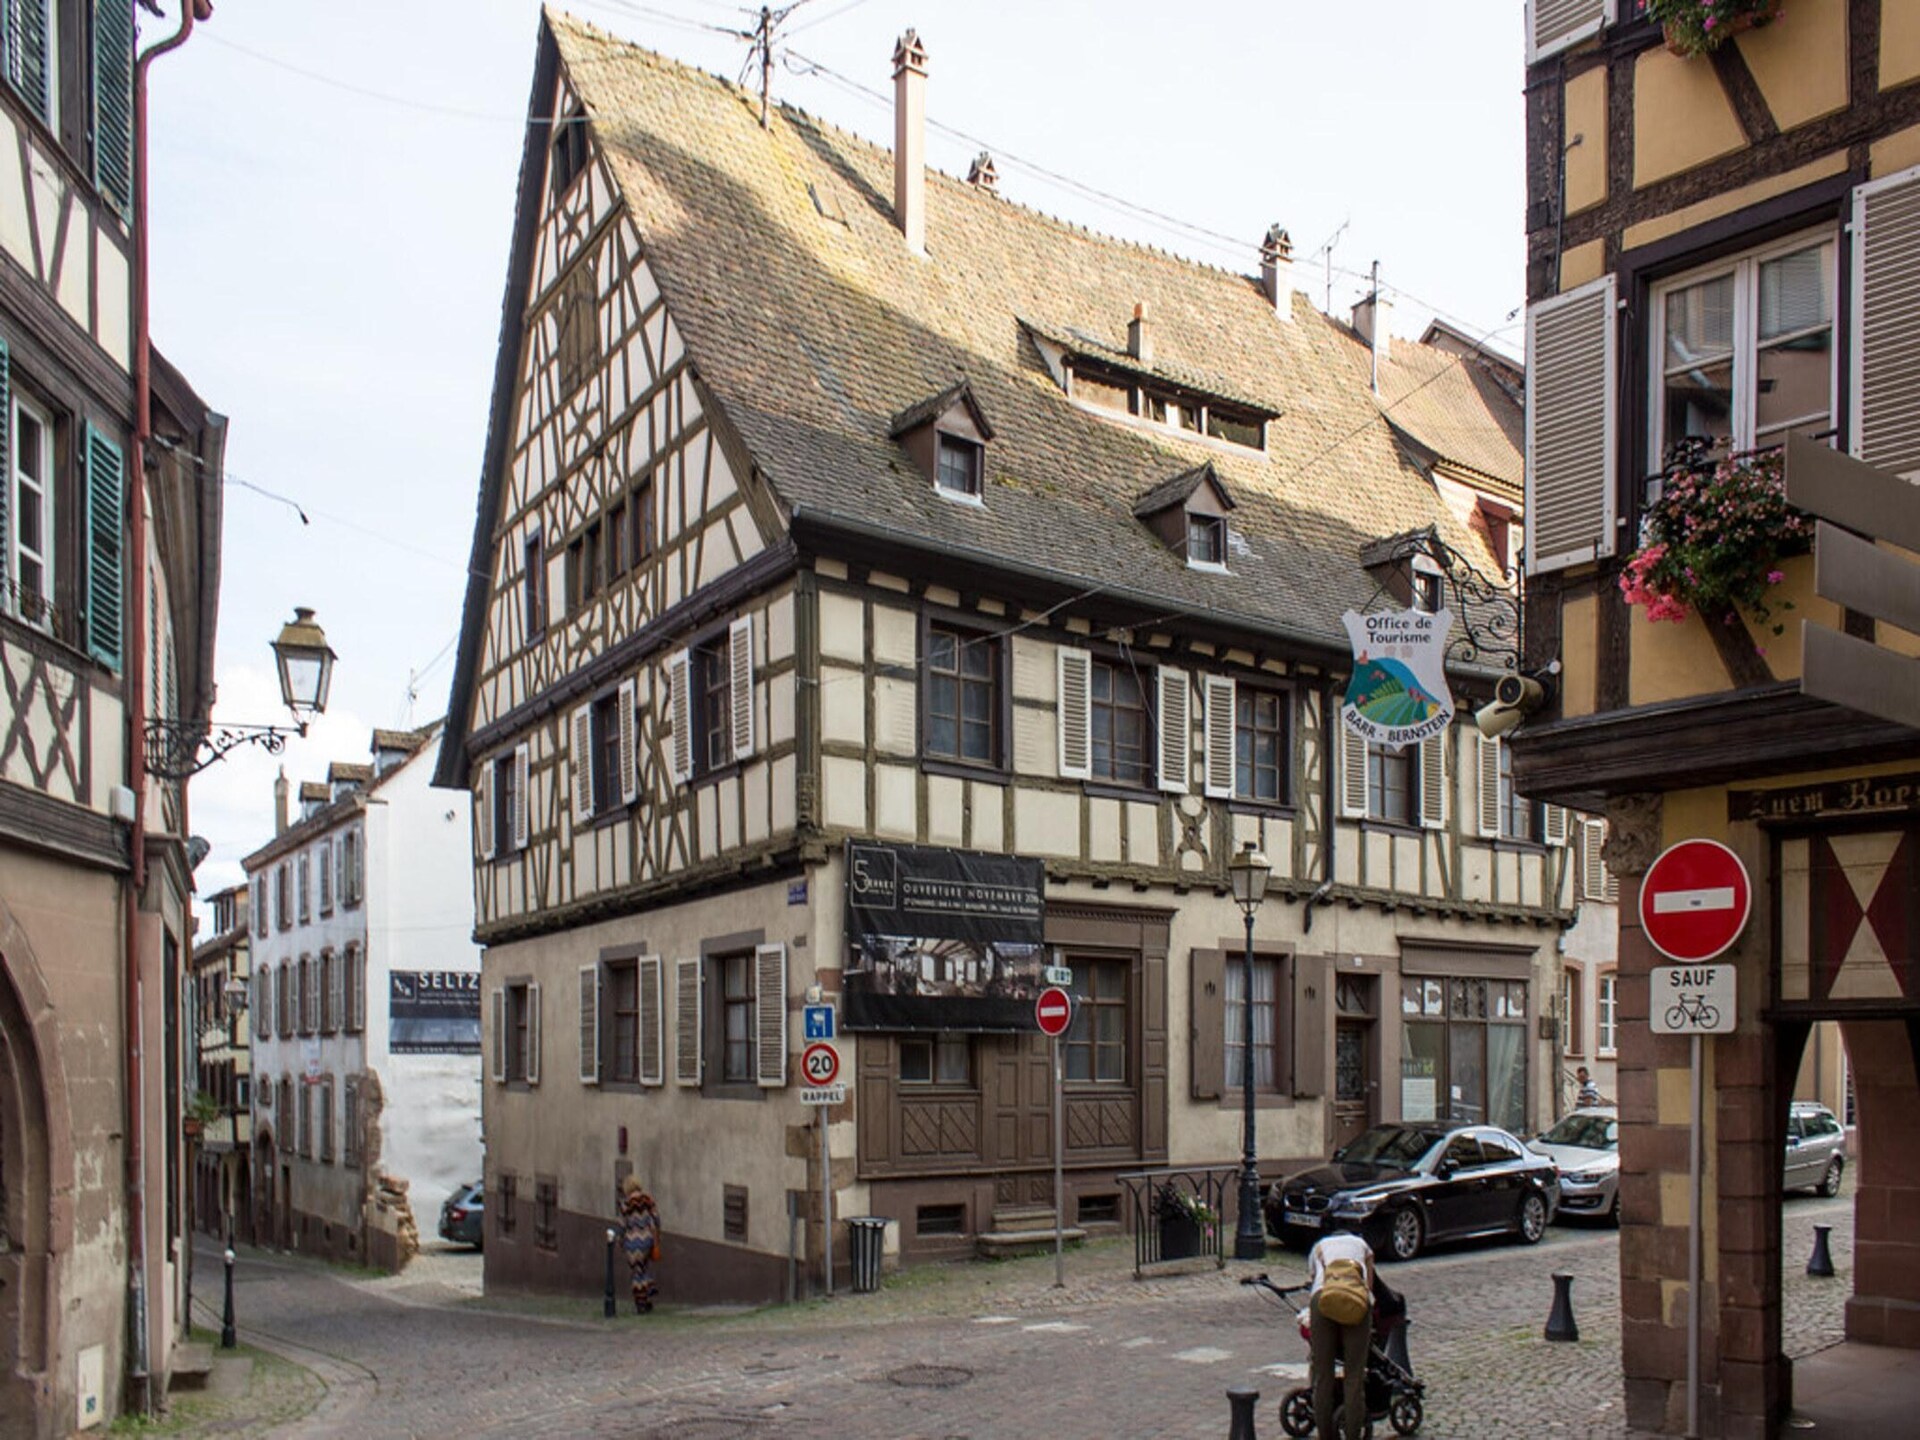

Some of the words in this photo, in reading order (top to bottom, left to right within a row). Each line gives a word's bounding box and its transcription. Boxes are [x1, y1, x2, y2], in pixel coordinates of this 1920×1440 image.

[1366, 617, 1409, 630] Office
[1415, 617, 1432, 629] de
[1368, 631, 1431, 643] Tourisme
[1346, 710, 1376, 738] BARR
[1388, 709, 1450, 742] BERNSTEIN
[419, 972, 479, 990] SELTZ
[1670, 968, 1716, 987] SAUF
[809, 1054, 833, 1074] 20
[802, 1091, 841, 1102] RAPPEL
